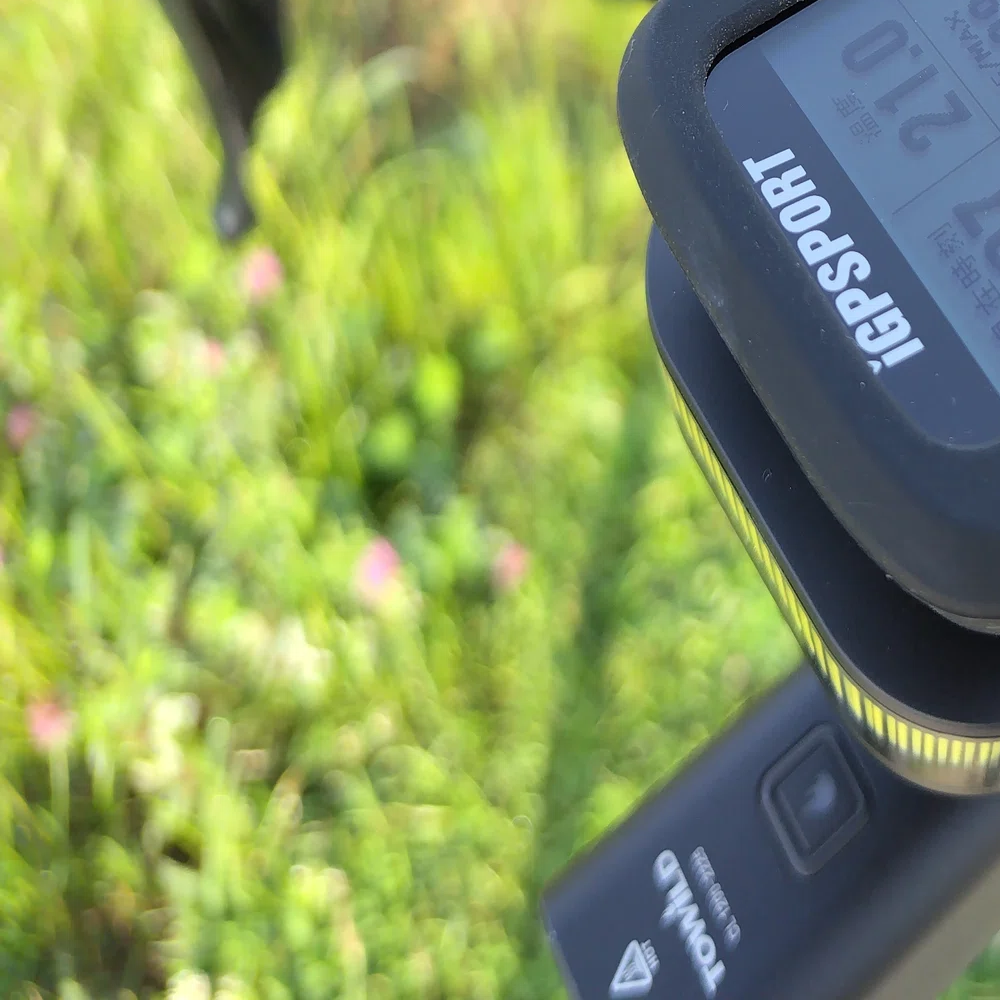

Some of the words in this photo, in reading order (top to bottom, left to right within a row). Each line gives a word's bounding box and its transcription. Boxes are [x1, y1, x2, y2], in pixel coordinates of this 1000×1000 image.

[829, 90, 883, 144] 温度
[840, 18, 973, 153] 21.0
[742, 149, 925, 375] iGPSPORT
